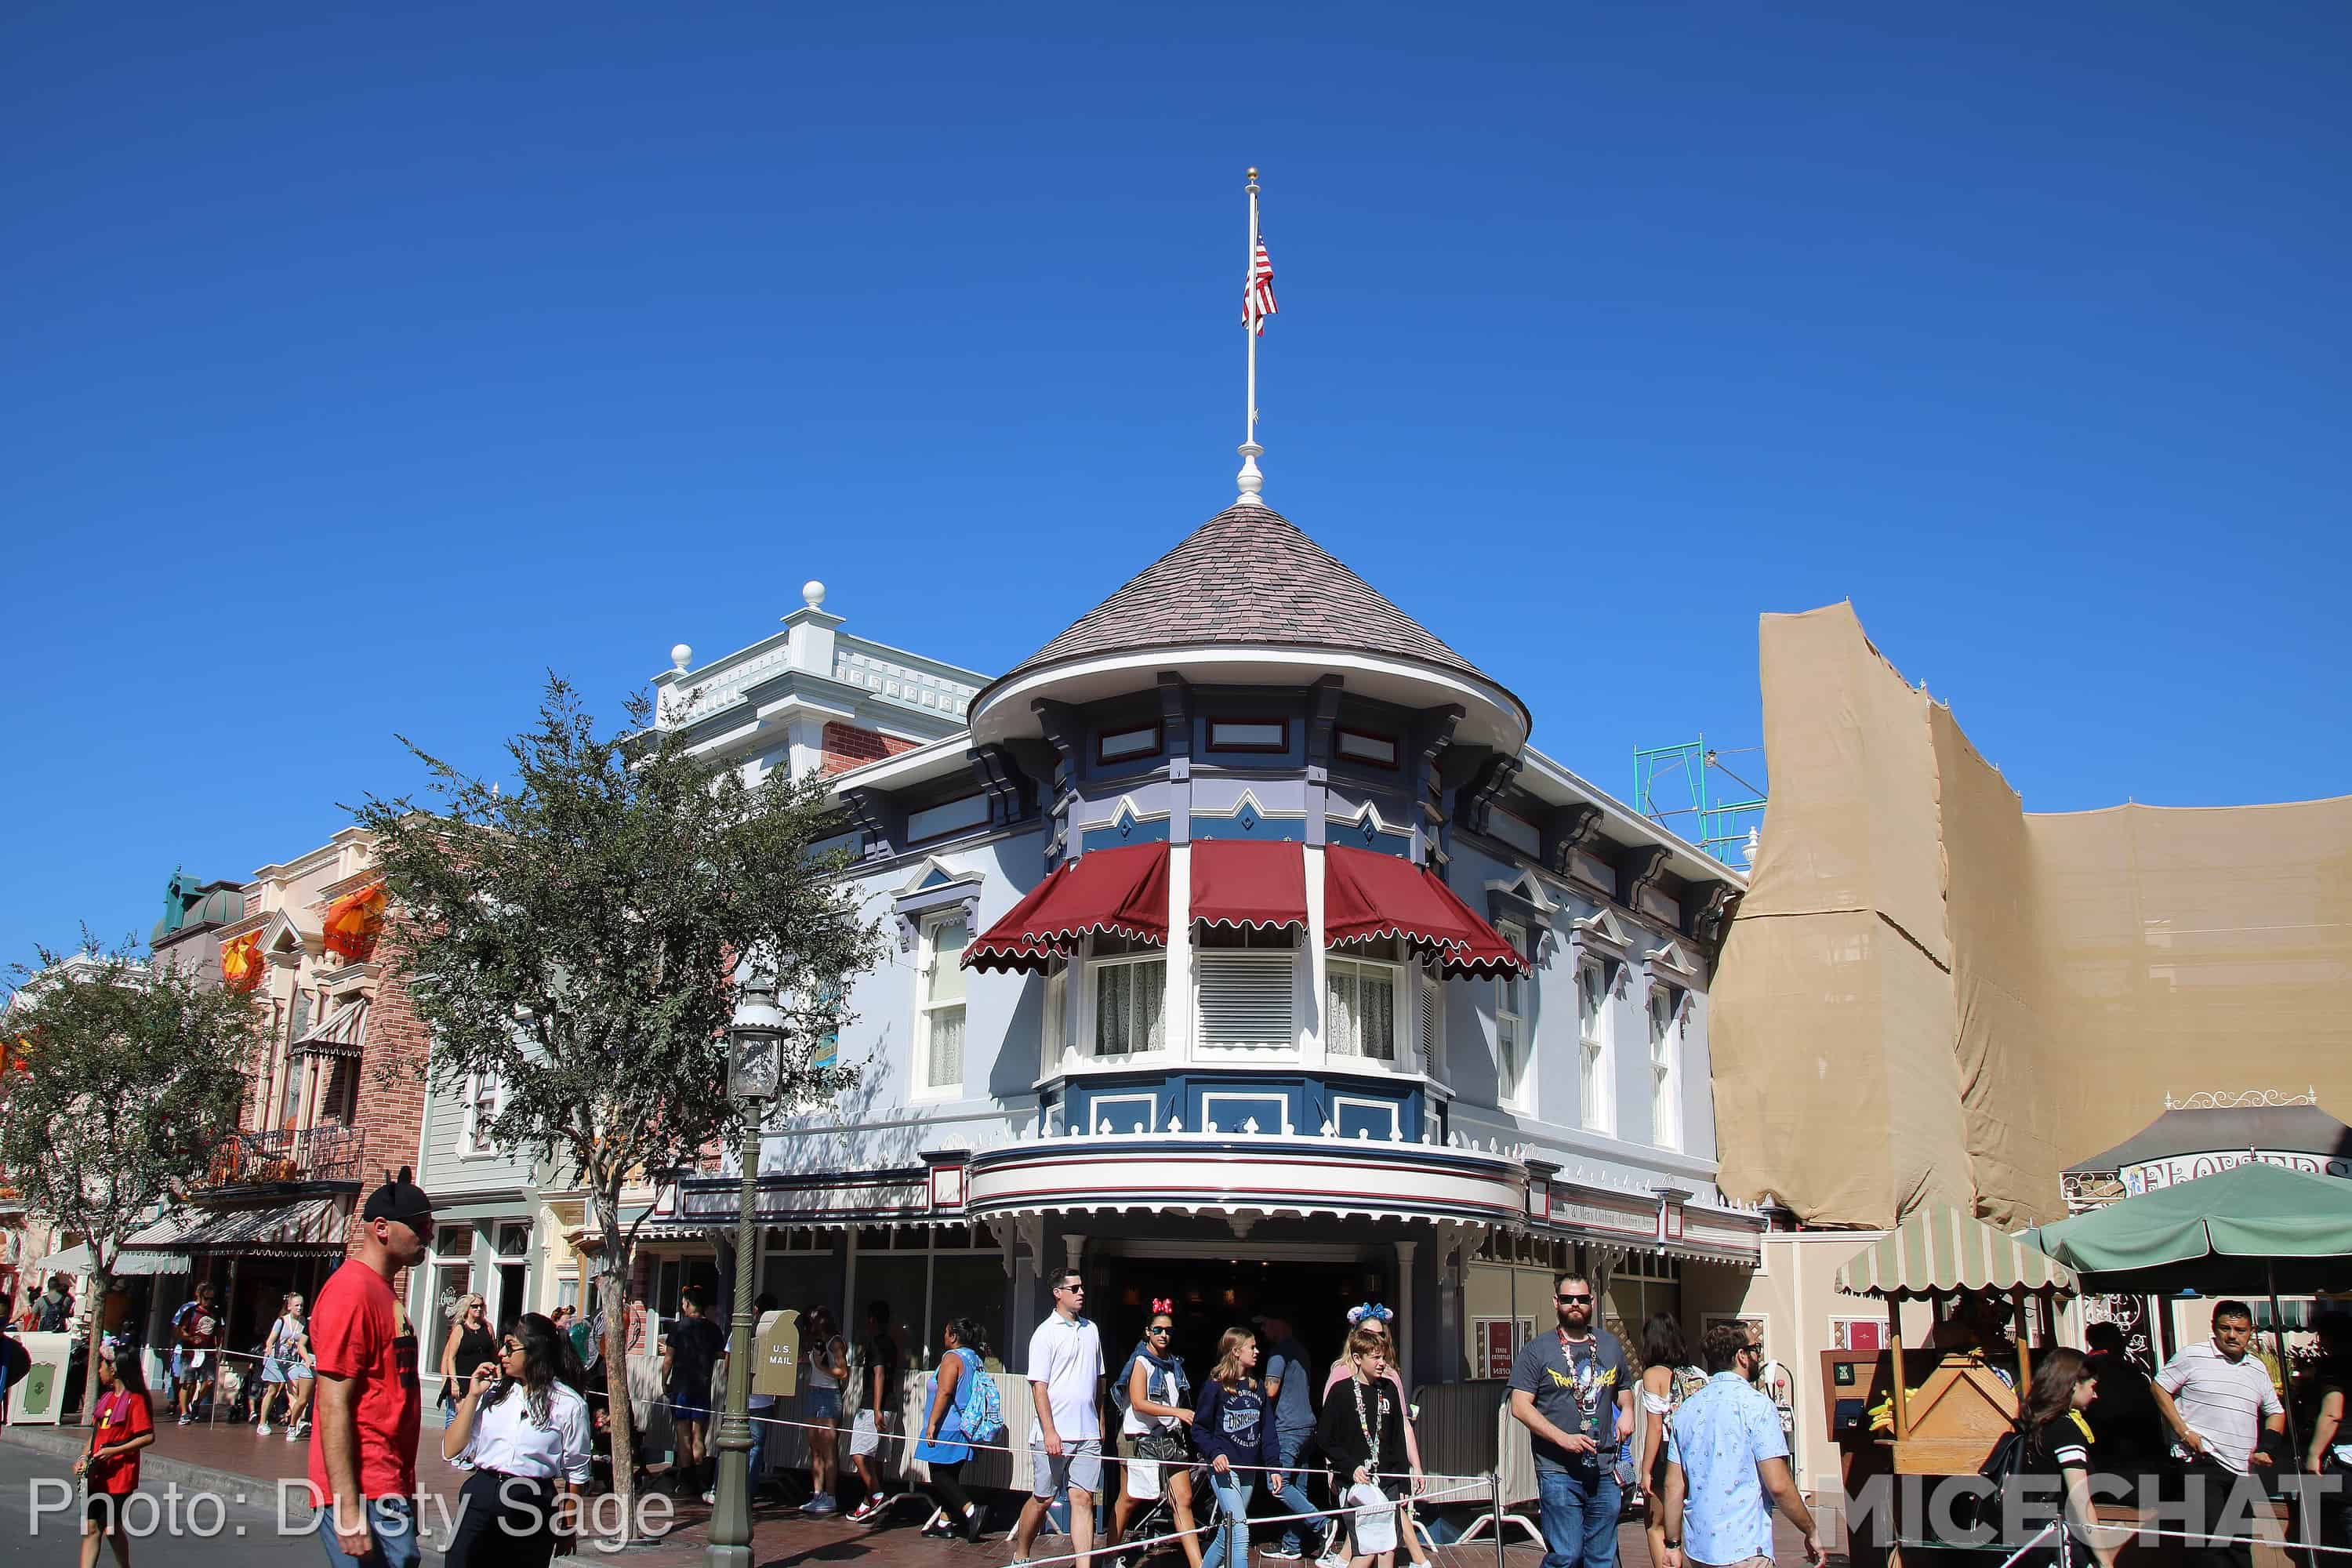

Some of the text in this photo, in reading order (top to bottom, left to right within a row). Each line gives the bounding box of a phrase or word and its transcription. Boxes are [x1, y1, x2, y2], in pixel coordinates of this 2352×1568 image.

[1571, 1207, 1577, 1218] &
[773, 1345, 791, 1354] U.S.
[770, 1356, 793, 1365] MAIL
[1230, 1433, 1261, 1448] ESTABLISH
